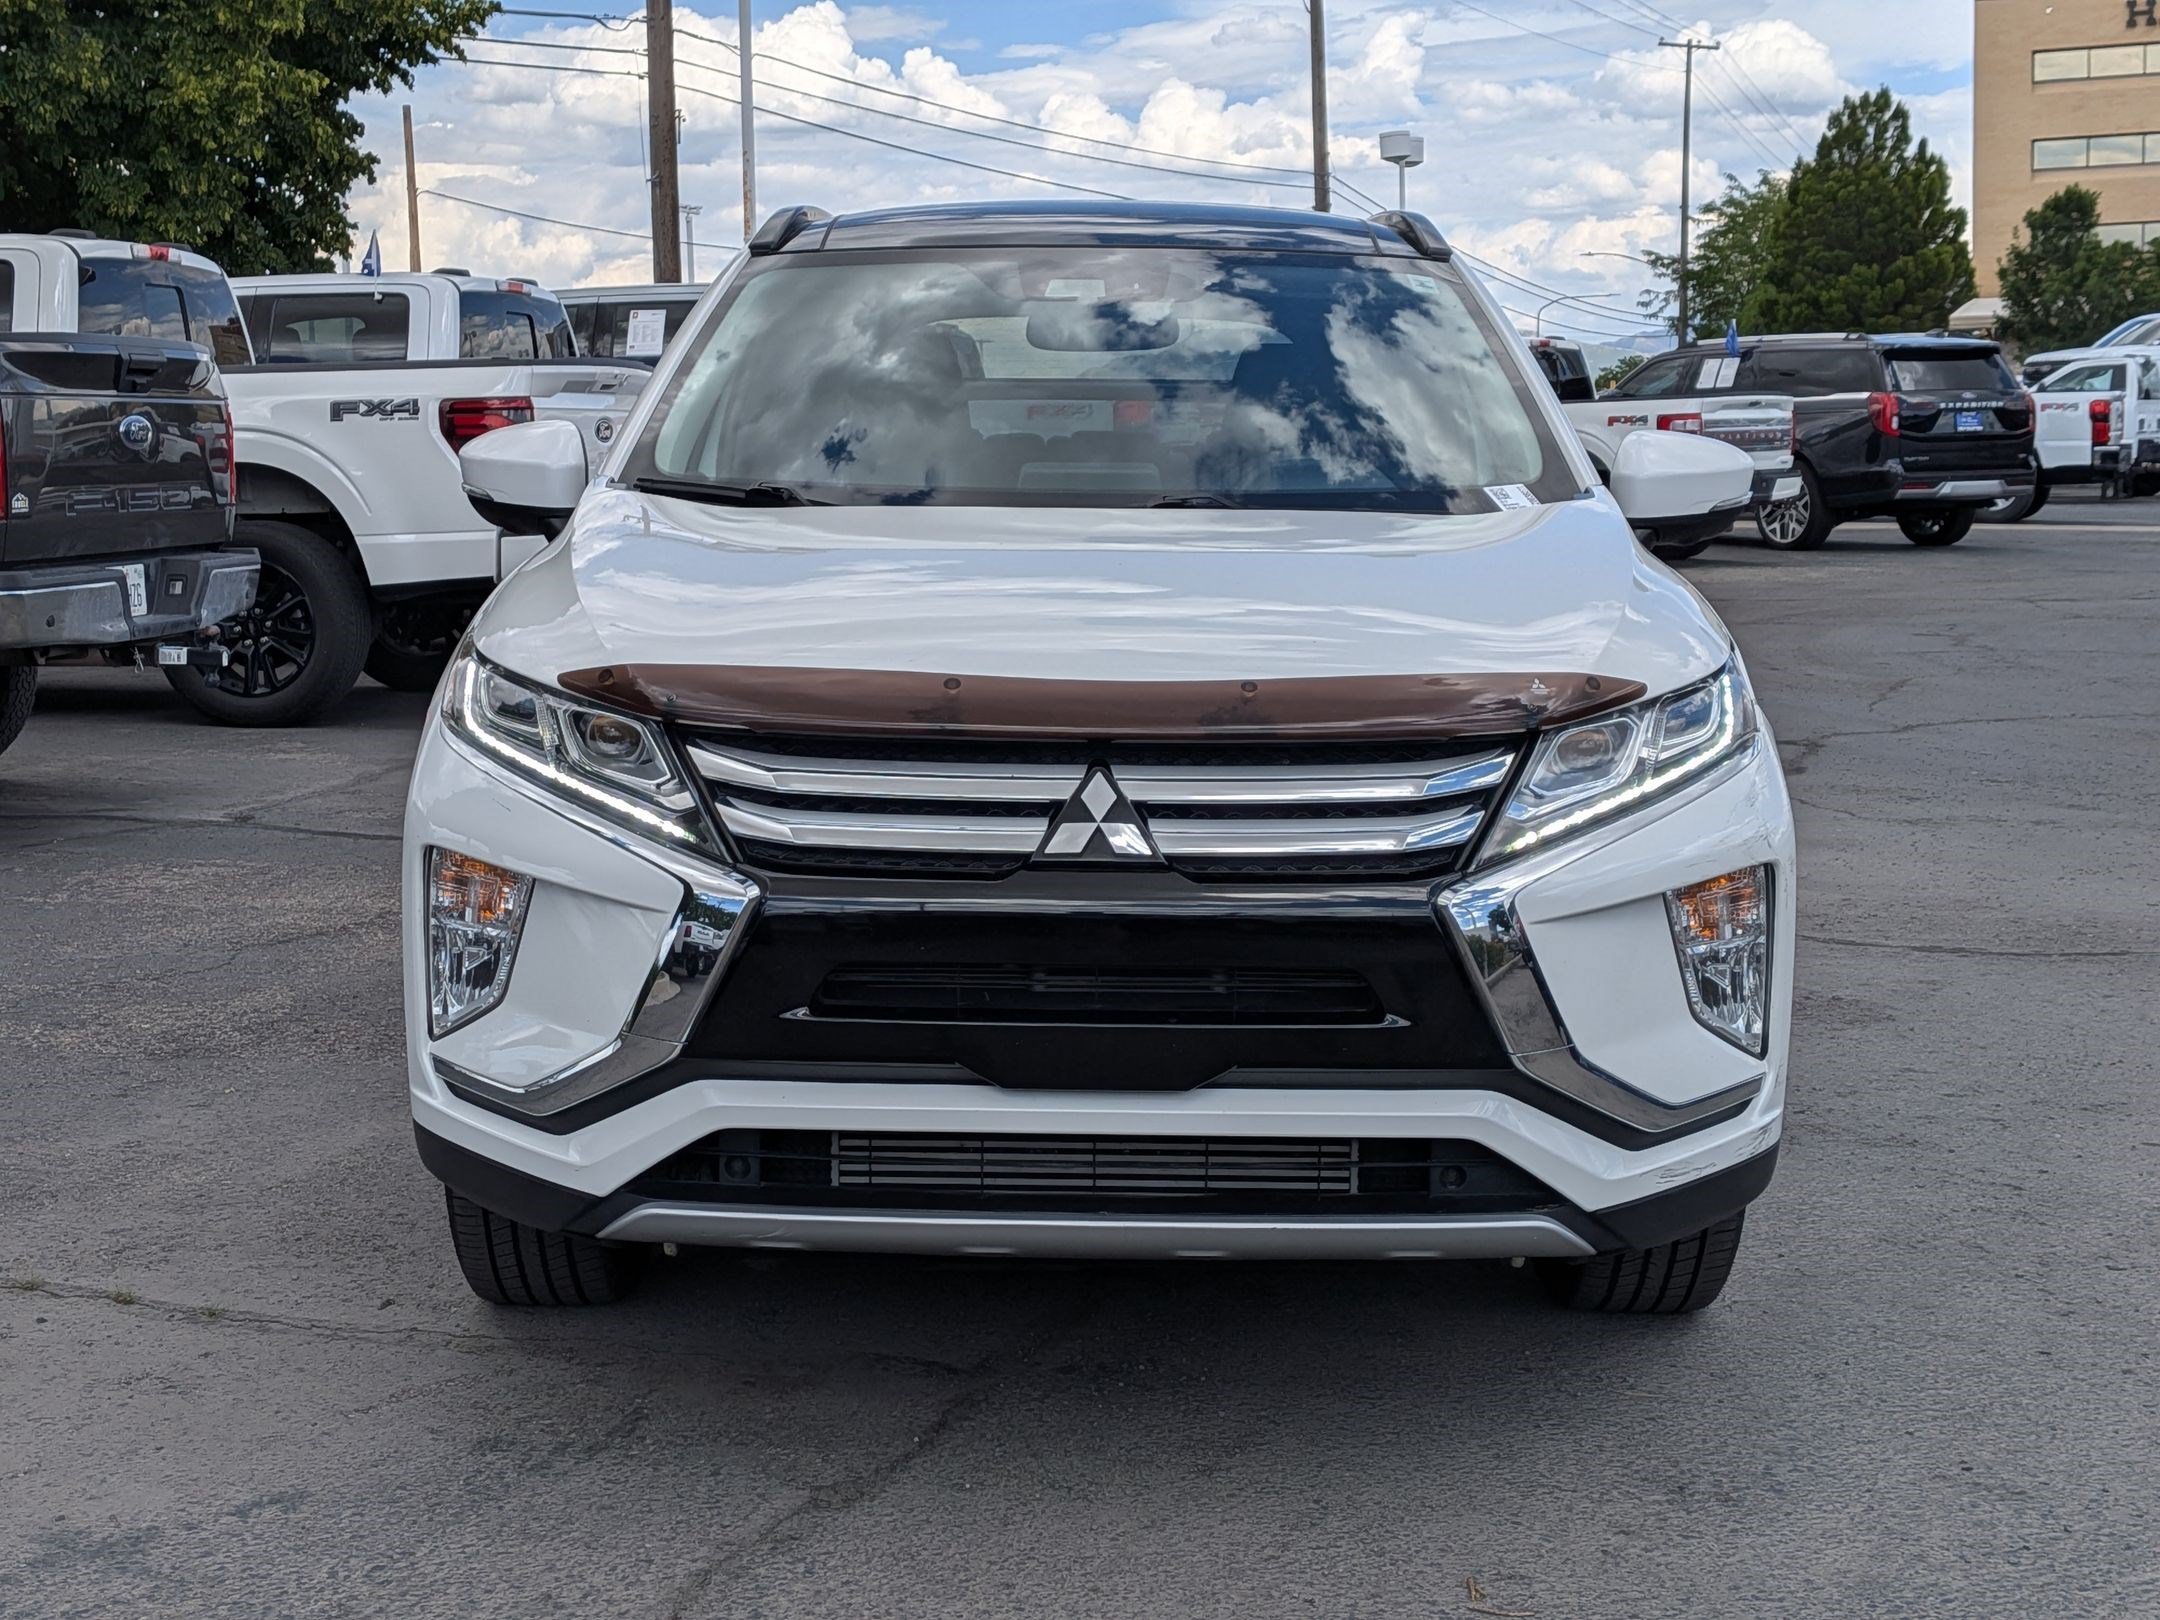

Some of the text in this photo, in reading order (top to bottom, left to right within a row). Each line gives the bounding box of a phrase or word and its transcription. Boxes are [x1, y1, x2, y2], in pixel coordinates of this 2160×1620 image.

[330, 398, 420, 422] FX4
[1939, 401, 2004, 409] EXPEDITION
[1607, 414, 1649, 427] FX4
